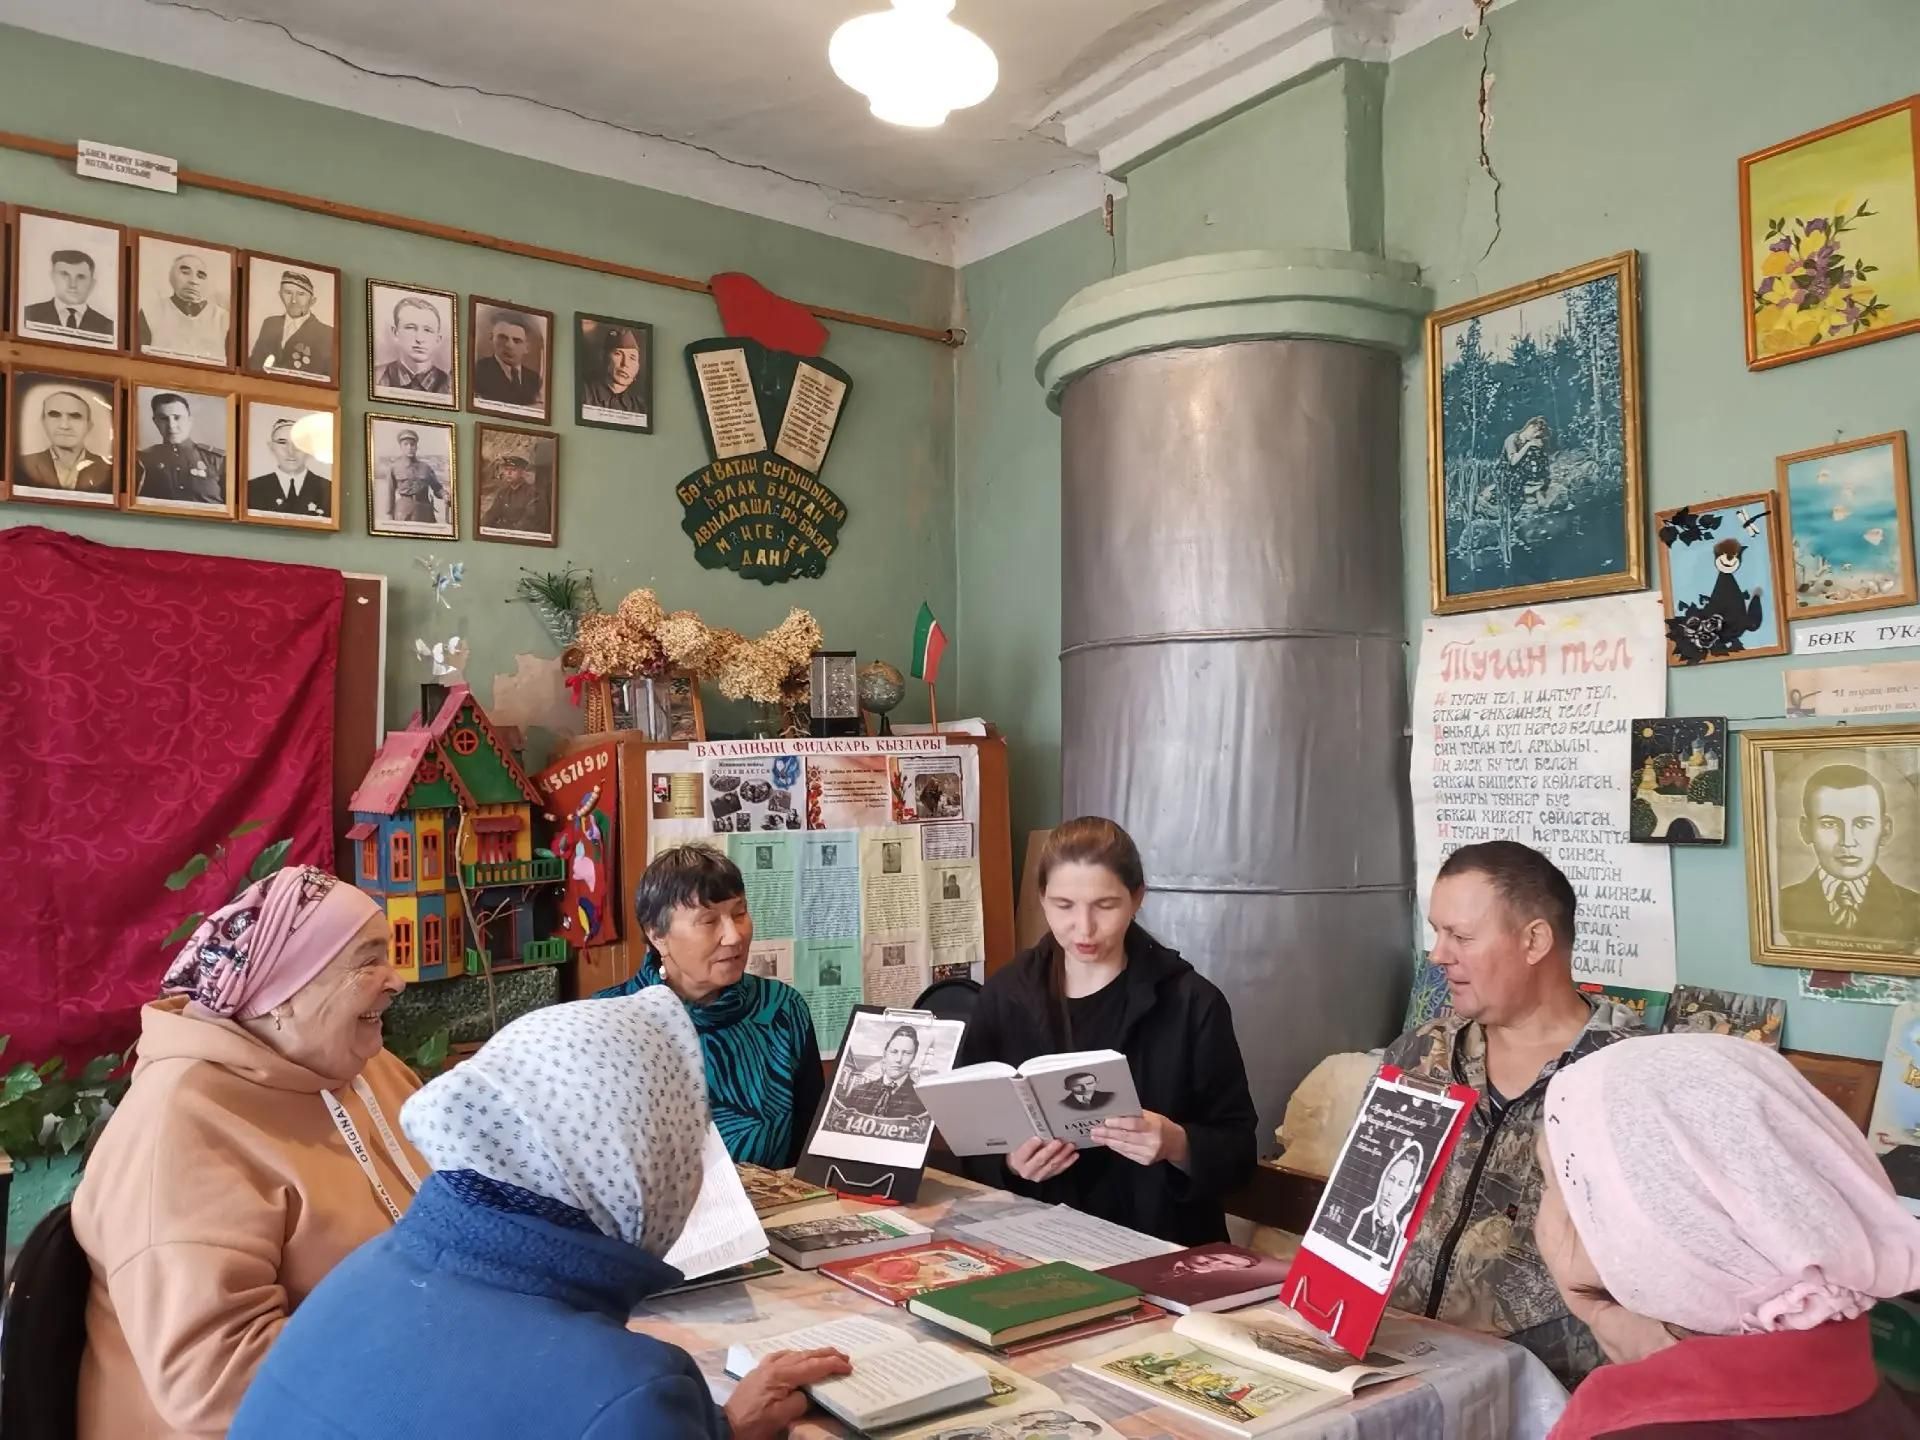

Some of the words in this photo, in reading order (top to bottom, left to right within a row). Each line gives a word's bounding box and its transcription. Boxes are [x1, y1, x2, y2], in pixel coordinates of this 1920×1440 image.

[712, 458, 759, 481] ВАТАН
[763, 460, 846, 522] СУГЫШЫНДА
[767, 481, 825, 524] БУЛГАН
[694, 498, 833, 557] АВЫЛДАШЛРЫБЫЗГА
[716, 524, 810, 558] МҢГЕЕК
[1440, 640, 1547, 683] Туган
[1561, 637, 1633, 674] тел
[1808, 630, 1857, 647] БӨЕК
[696, 741, 787, 757] ВАТАННЫҢ
[792, 740, 870, 754] ФИДАКАРЬ
[876, 739, 941, 752] КЫЗЛАРЫ
[334, 1105, 368, 1163] ORIGINAL
[843, 1116, 876, 1135] 140
[875, 1122, 910, 1139] лет
